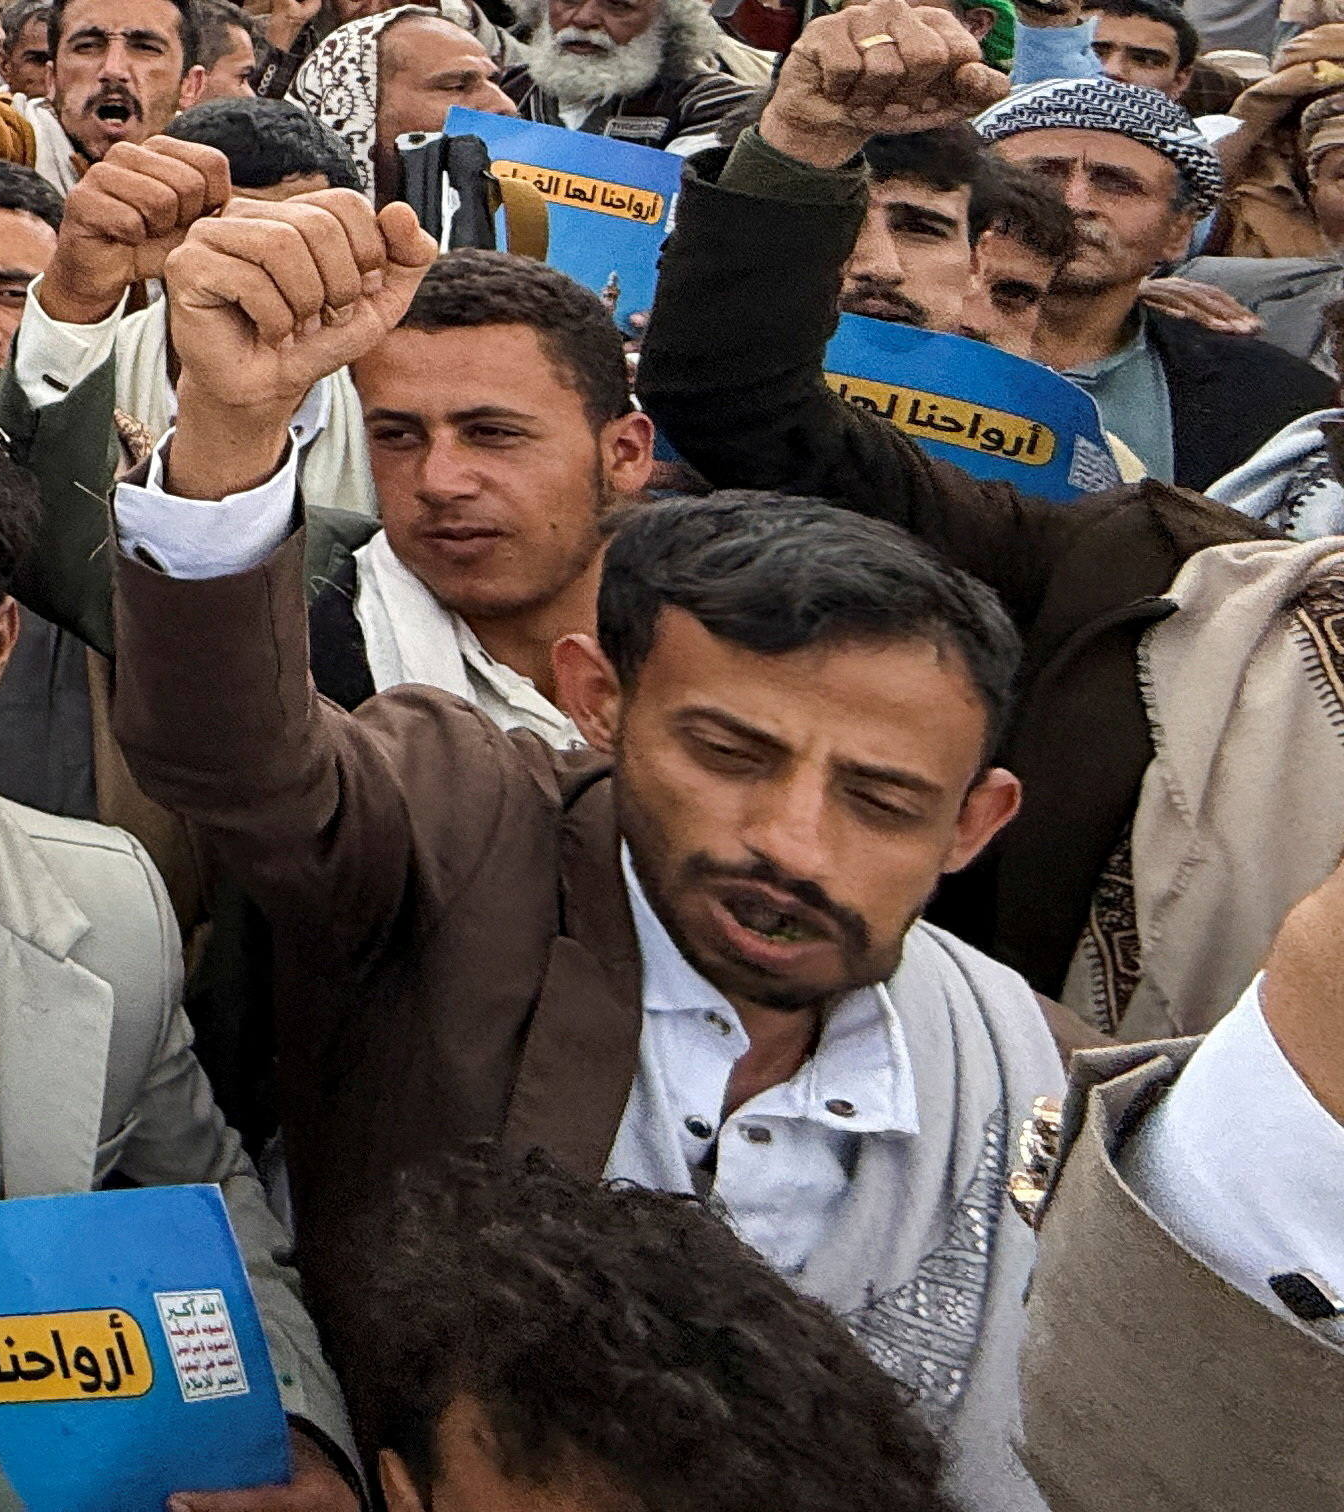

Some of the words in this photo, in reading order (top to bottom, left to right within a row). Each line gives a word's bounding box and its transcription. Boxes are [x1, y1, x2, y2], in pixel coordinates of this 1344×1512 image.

[564, 180, 598, 204] لها
[601, 187, 660, 221] أرواحنا
[908, 399, 1042, 457] أرواحنا
